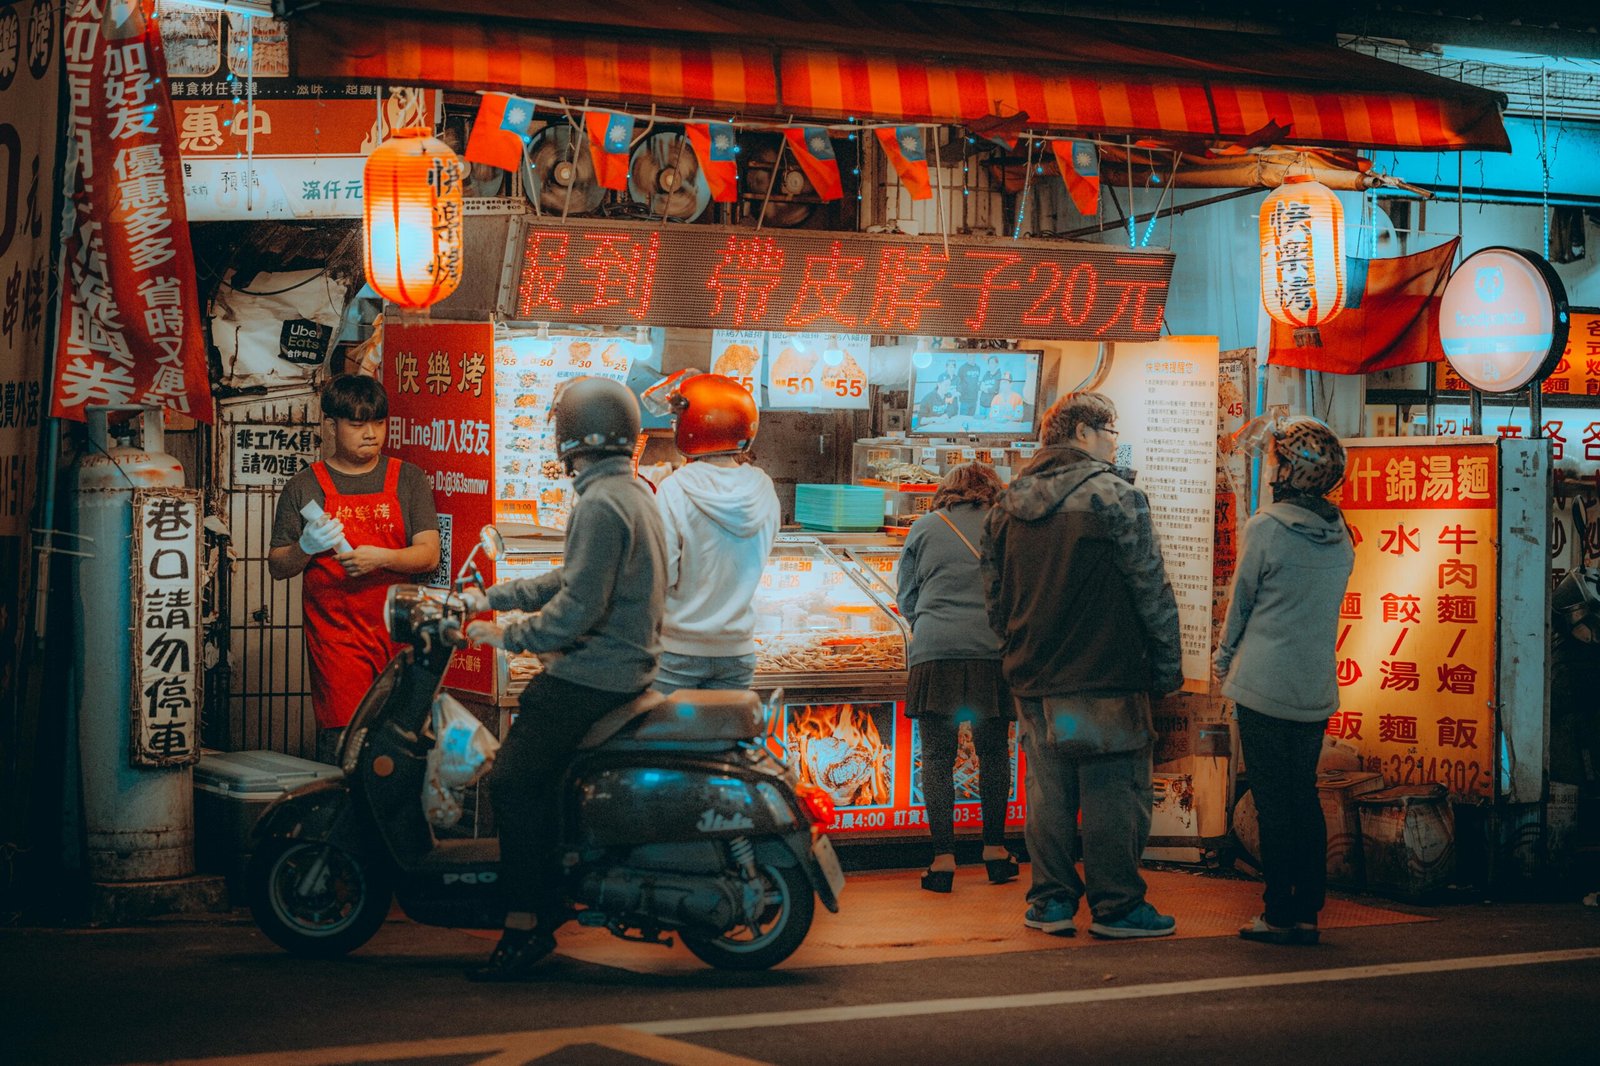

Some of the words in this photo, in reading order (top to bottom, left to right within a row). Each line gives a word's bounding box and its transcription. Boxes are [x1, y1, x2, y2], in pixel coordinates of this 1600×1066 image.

[103, 42, 160, 139] 加好友
[113, 143, 177, 273] 優惠多多
[302, 180, 366, 200] 滿仟元
[136, 277, 191, 414] 省時又便利
[288, 336, 320, 350] Eats
[395, 350, 487, 398] 快樂烤
[577, 360, 592, 369] 30
[613, 363, 628, 372] 25
[0, 380, 40, 428] 費外送
[786, 377, 814, 395] 50
[834, 379, 862, 397] 55
[1227, 402, 1243, 416] 45
[237, 429, 312, 453] 非工作人員
[387, 415, 491, 456] 用Line加入好友
[1327, 455, 1490, 503] 什錦湯麵
[798, 561, 812, 572] 30
[879, 561, 893, 572] 20
[145, 500, 193, 756] 巷口請勿停車
[1326, 529, 1363, 741] 麵/炒飯
[1379, 524, 1421, 745] 水餃/湯麵
[1437, 524, 1479, 749] 牛肉麵/燴飯
